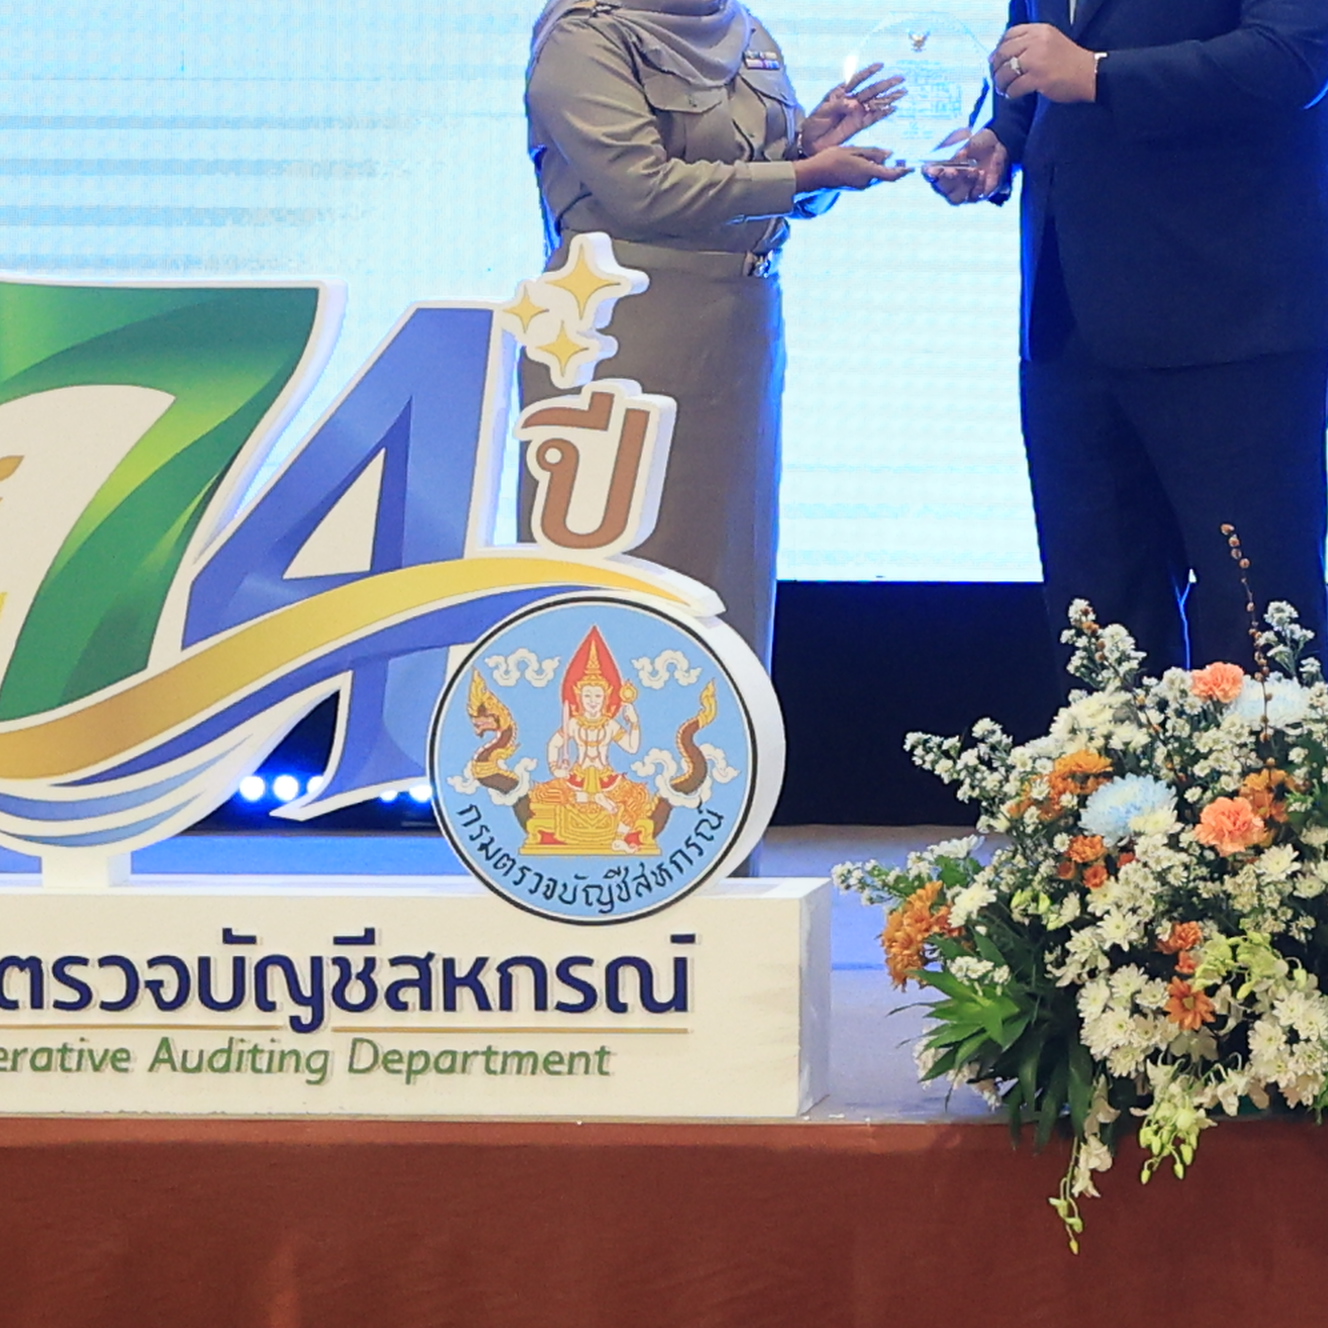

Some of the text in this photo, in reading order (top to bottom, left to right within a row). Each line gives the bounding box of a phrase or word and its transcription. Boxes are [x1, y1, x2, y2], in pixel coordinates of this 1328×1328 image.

[519, 390, 651, 550] ปี
[456, 794, 725, 914] กรมตรวจบัญชีสหกรณ์
[147, 1036, 329, 1085] Auditing
[350, 1037, 613, 1085] Department
